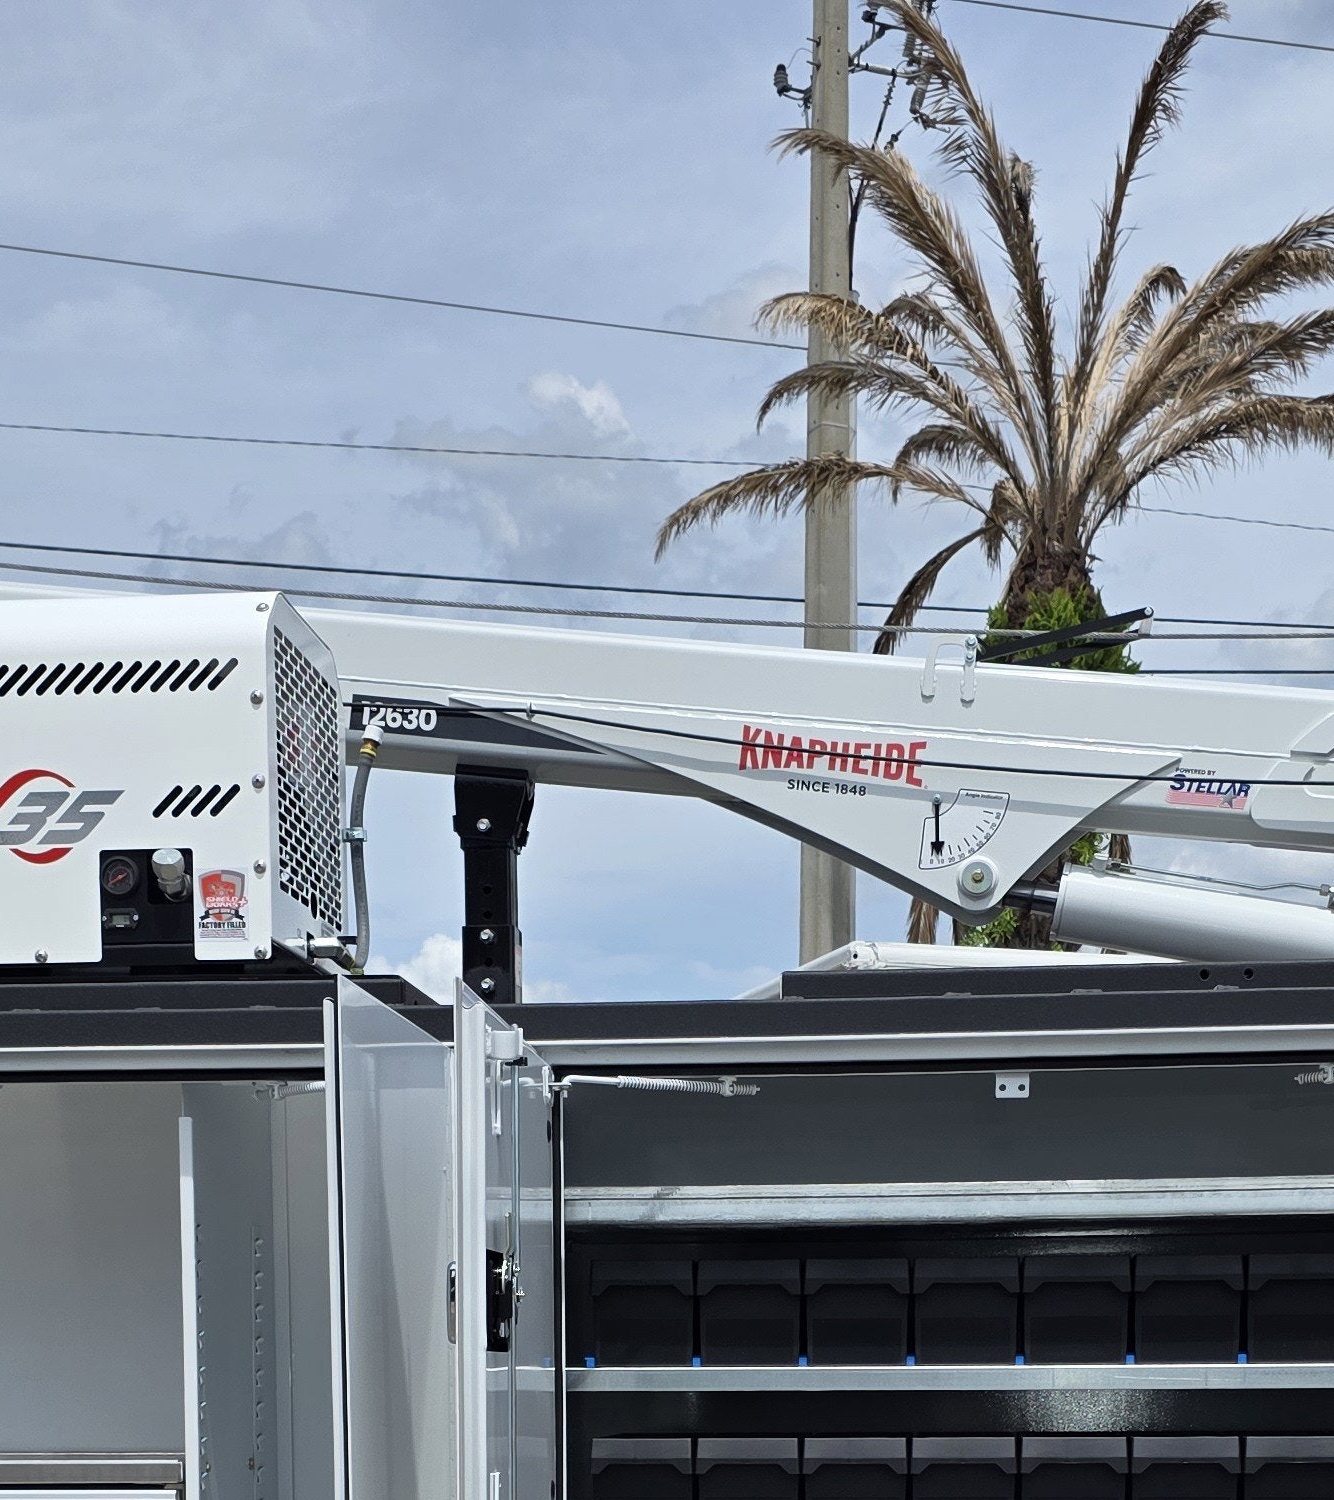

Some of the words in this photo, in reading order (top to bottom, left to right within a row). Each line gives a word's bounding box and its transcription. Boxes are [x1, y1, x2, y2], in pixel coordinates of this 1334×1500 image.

[361, 700, 437, 731] 12630
[739, 724, 927, 788] KNAPHEIDE
[1175, 766, 1207, 775] POWERED
[787, 778, 830, 793] SINCE
[835, 783, 867, 796] 1848
[1169, 773, 1251, 797] STELLAR
